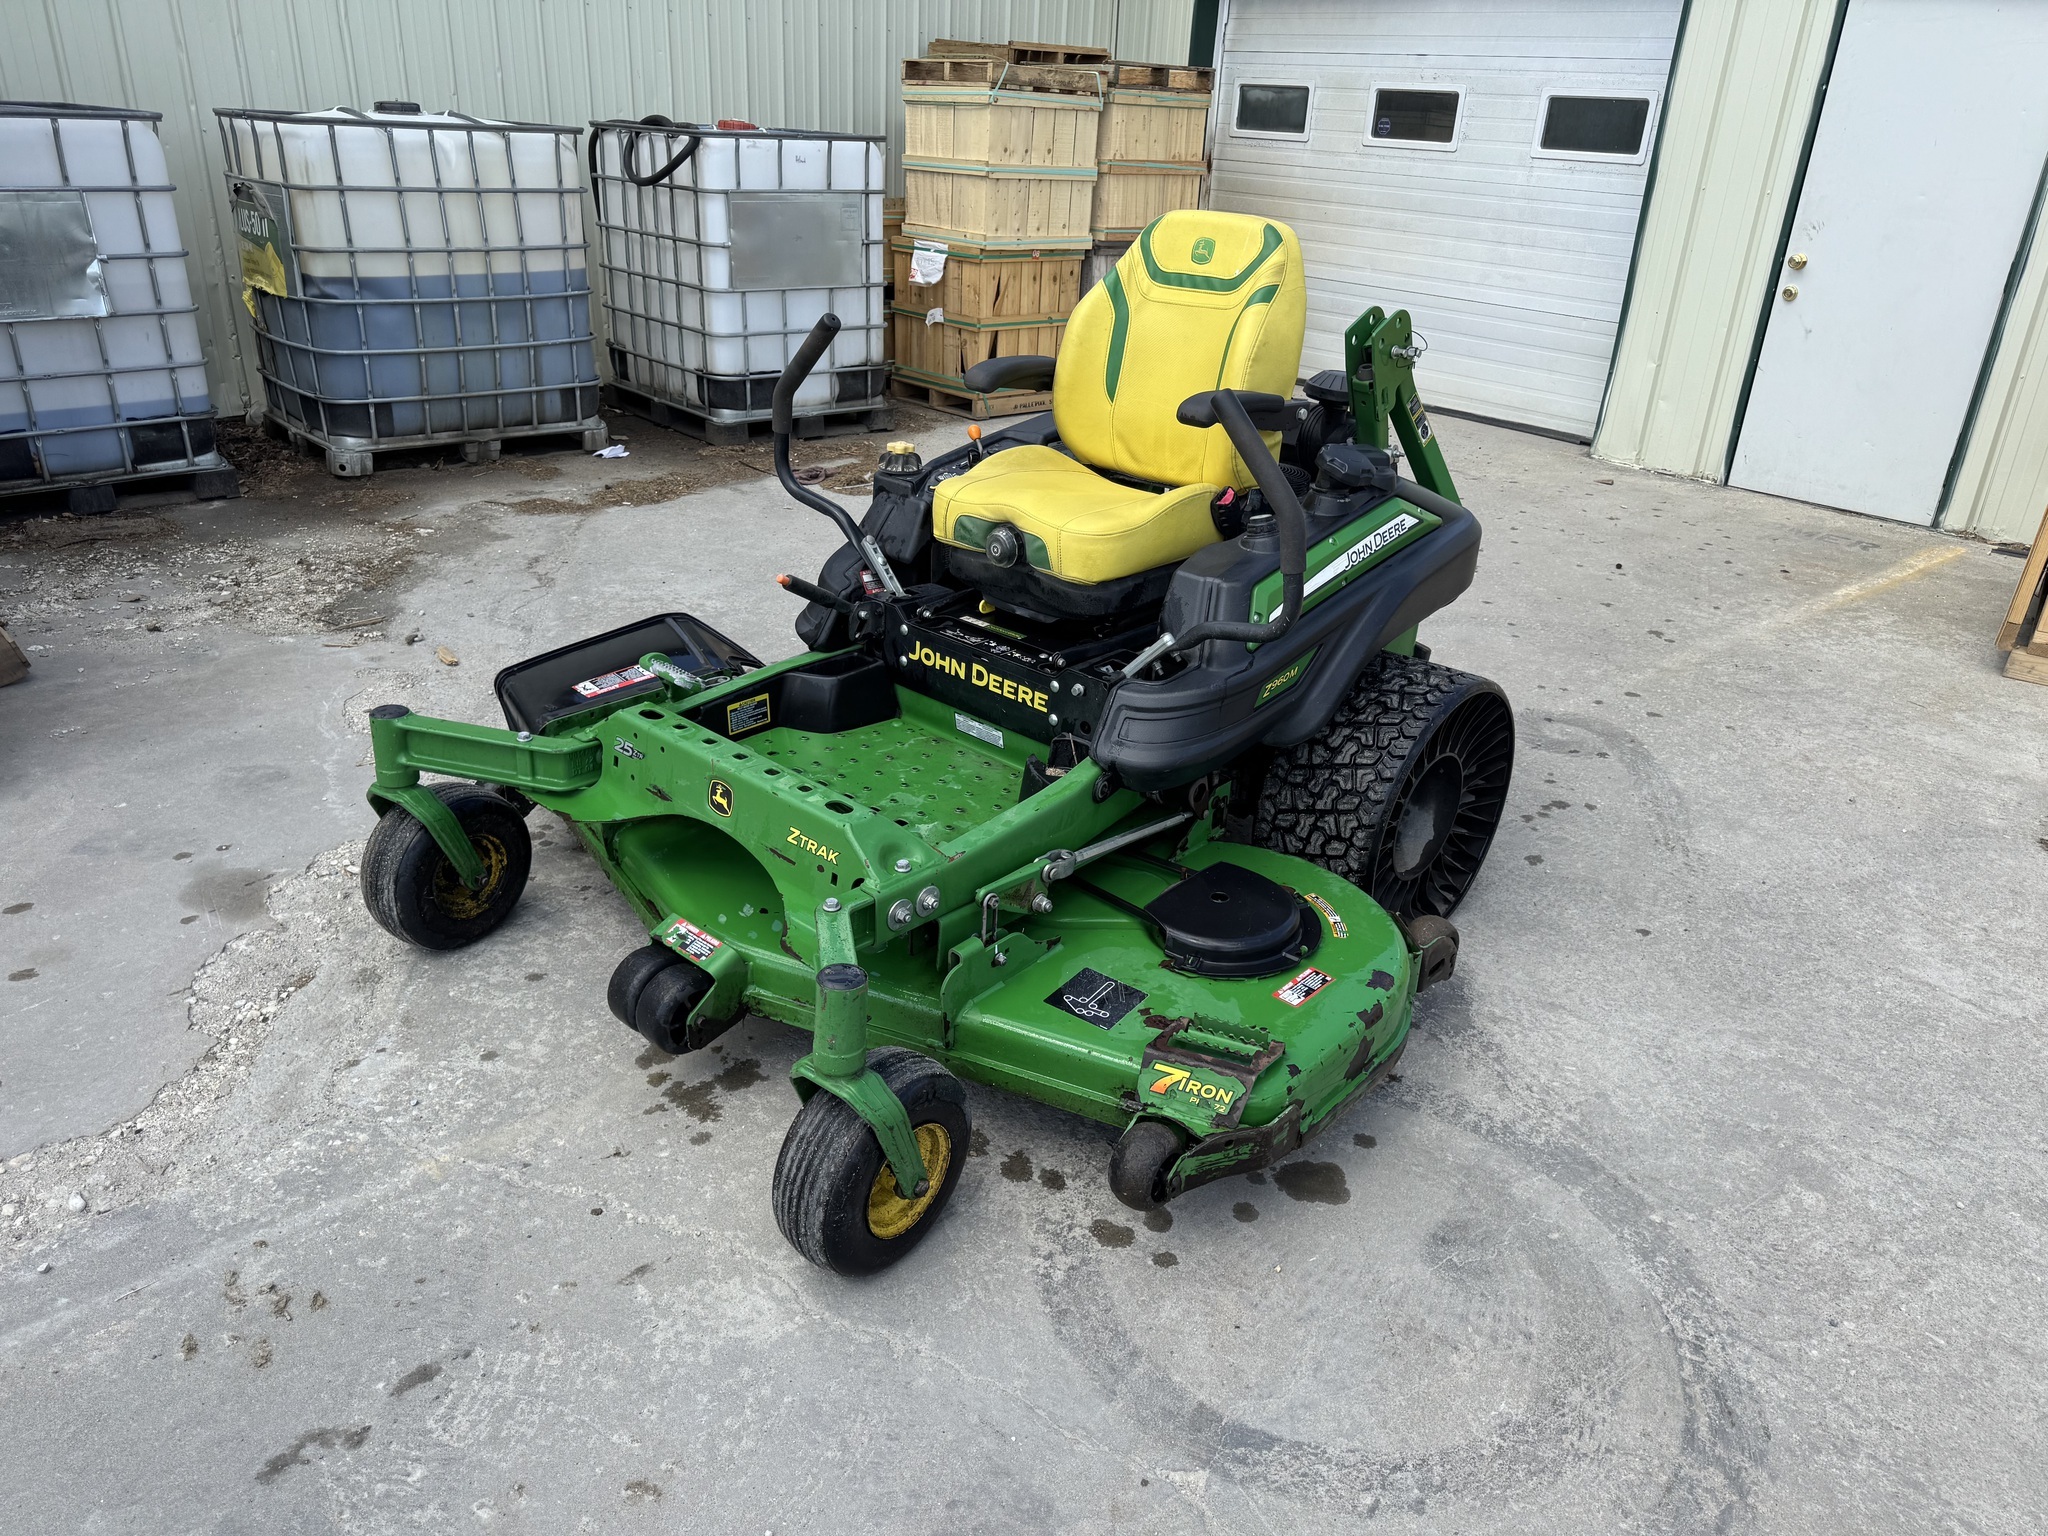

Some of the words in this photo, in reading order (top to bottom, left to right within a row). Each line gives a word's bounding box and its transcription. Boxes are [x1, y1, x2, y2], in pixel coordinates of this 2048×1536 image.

[1345, 541, 1373, 569] JOHN
[1373, 519, 1407, 548] DEERE
[908, 640, 966, 680] JOHN
[971, 663, 1049, 713] DEERE
[1262, 666, 1299, 699] Z960M
[614, 736, 633, 757] 25
[786, 826, 841, 865] ZTRAK
